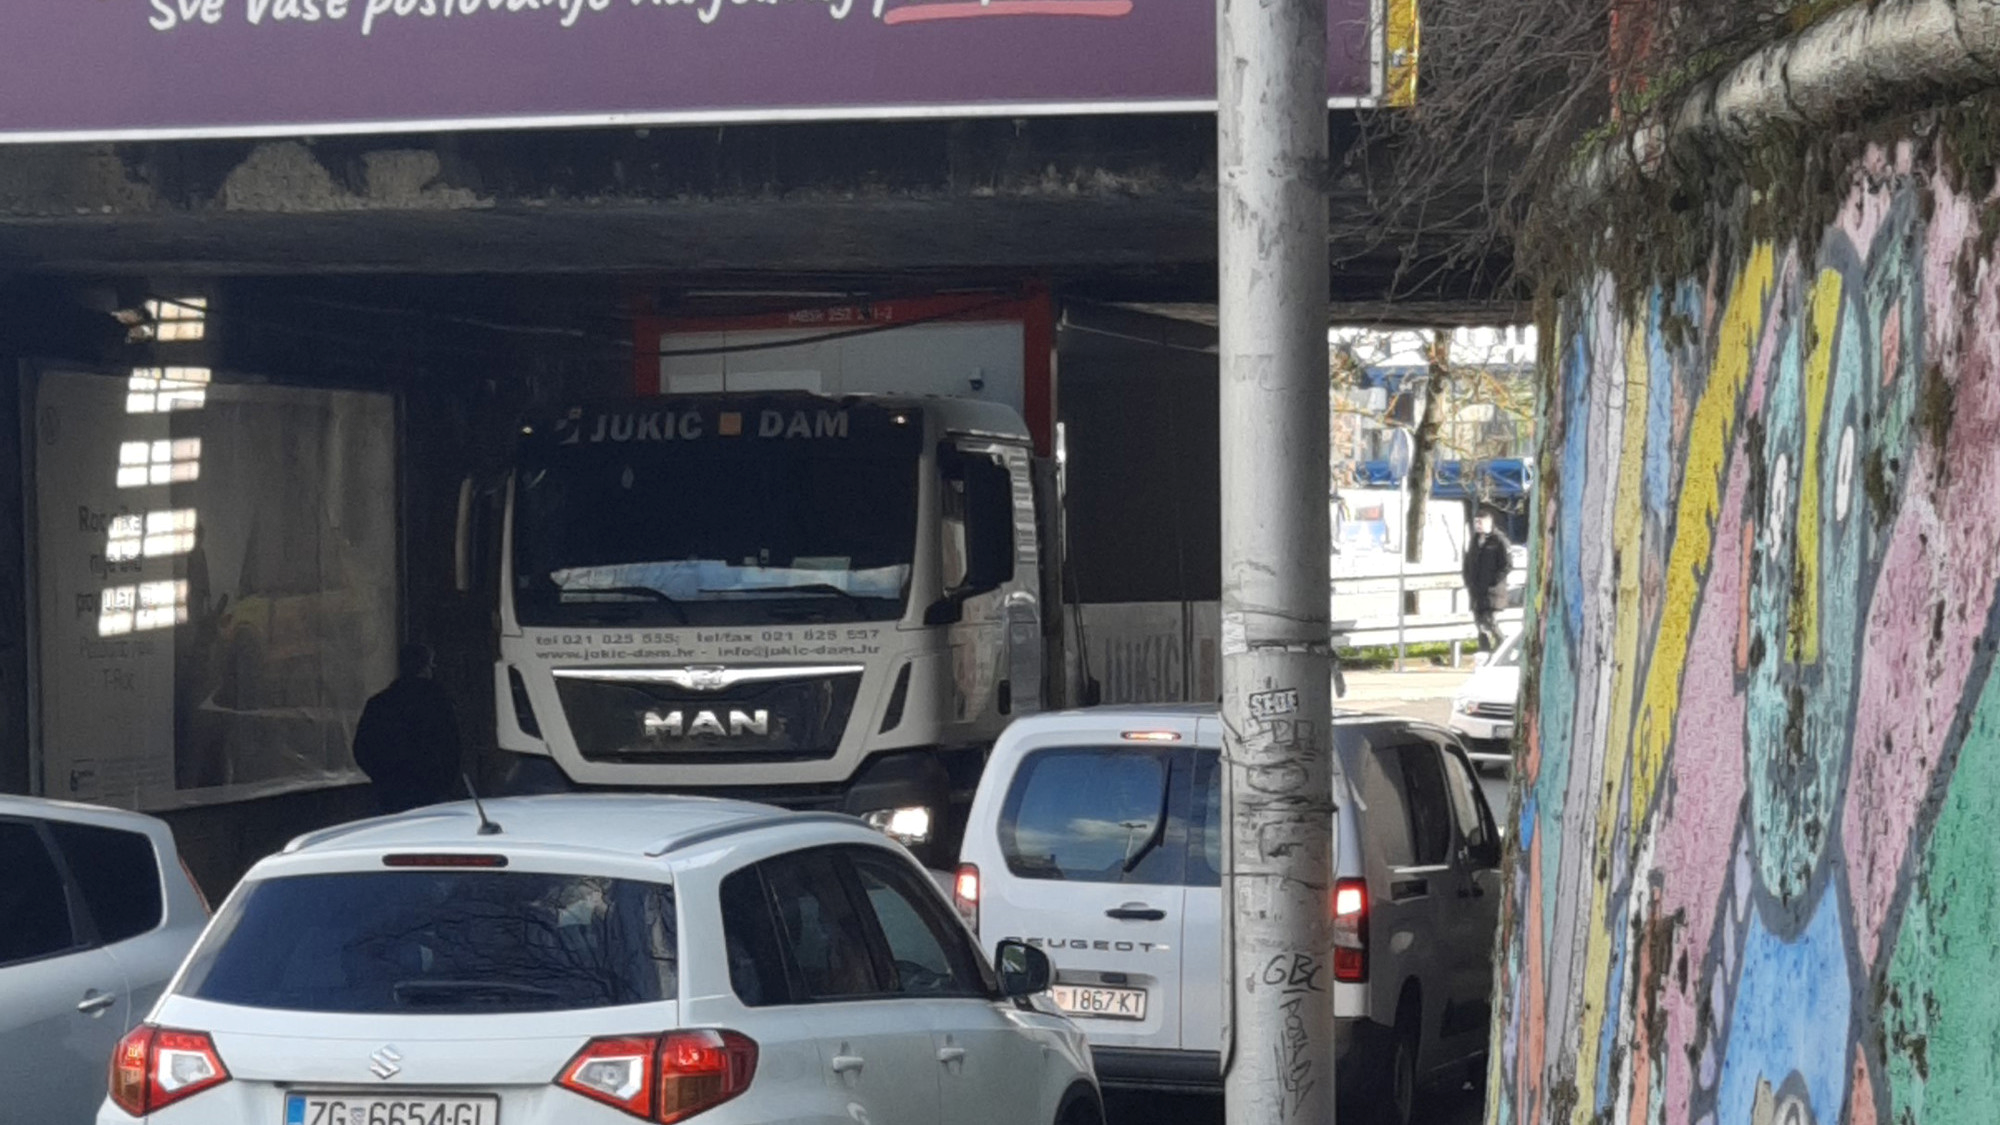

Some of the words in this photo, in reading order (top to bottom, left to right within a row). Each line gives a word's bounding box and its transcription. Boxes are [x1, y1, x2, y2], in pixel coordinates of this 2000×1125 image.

[758, 409, 849, 439] DAM
[762, 630, 793, 642] 021
[644, 710, 768, 736] MAN
[309, 1101, 346, 1125] ZG
